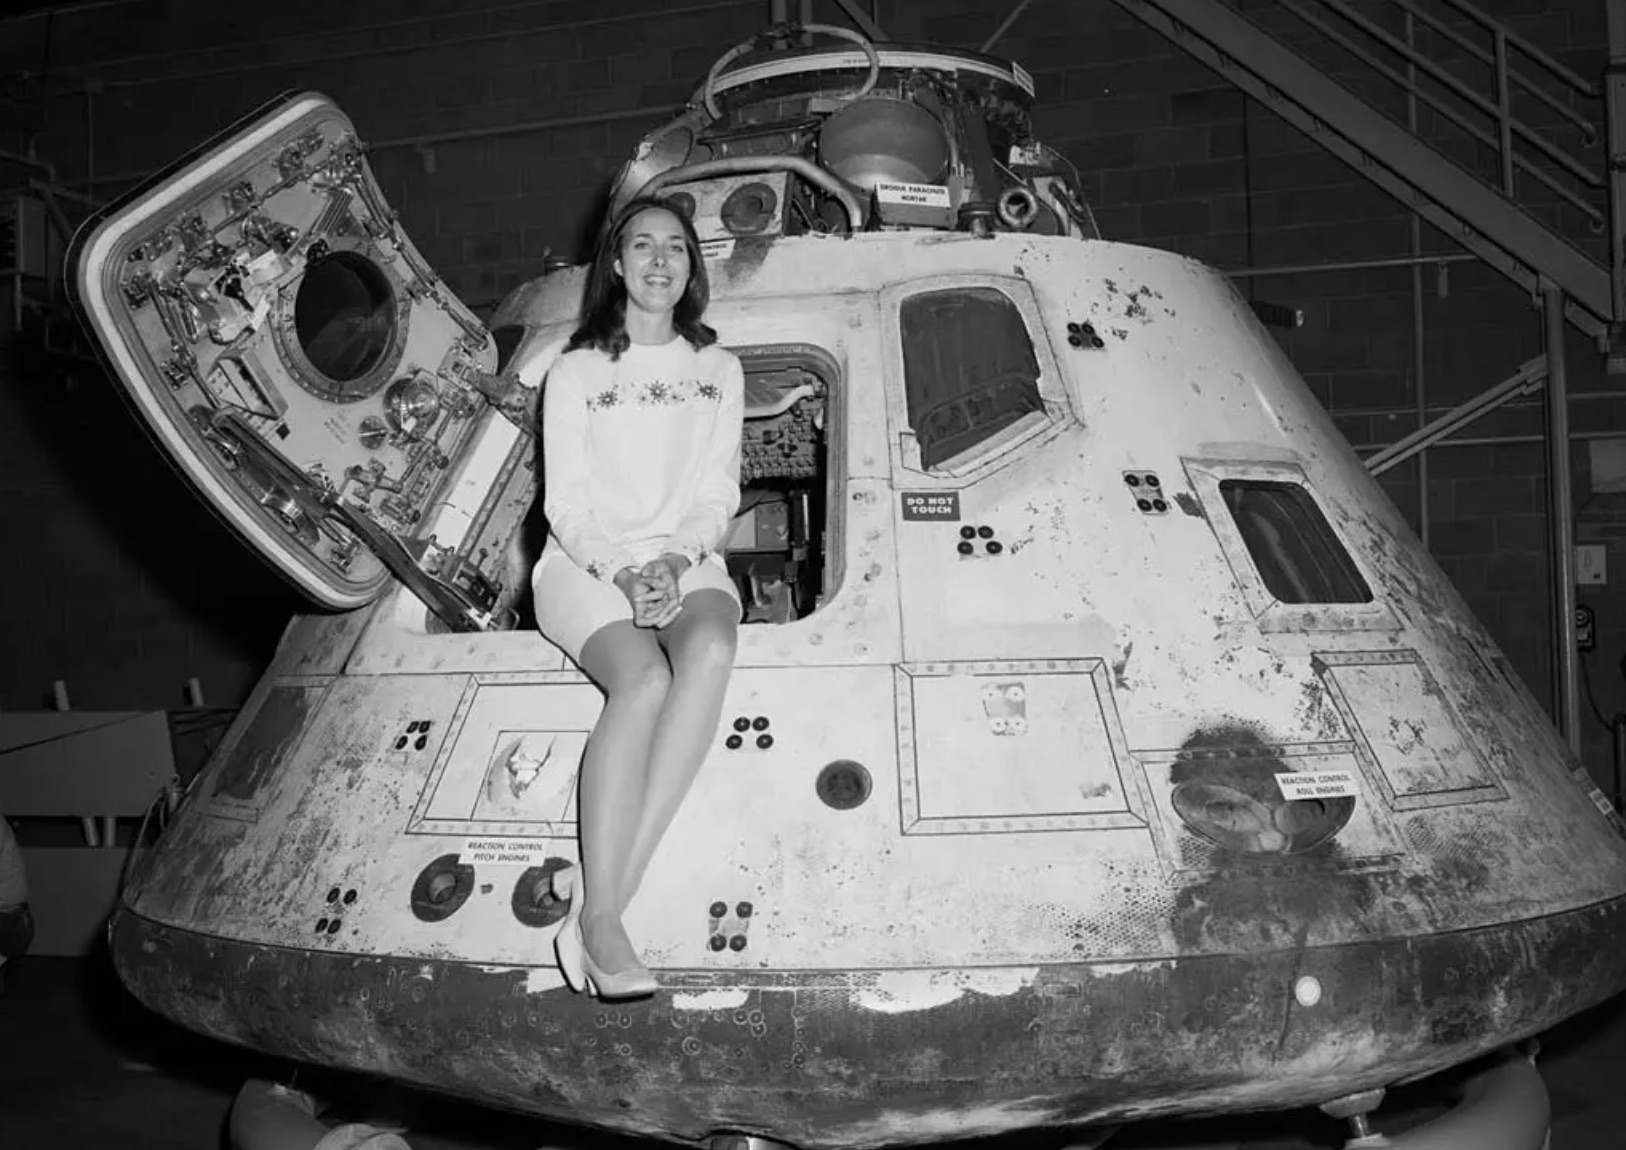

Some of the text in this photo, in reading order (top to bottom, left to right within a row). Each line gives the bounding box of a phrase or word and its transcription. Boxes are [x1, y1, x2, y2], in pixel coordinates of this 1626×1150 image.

[909, 186, 946, 195] PARACHUTE
[907, 497, 954, 506] DO NOT
[911, 506, 952, 514] TOUCH
[1280, 775, 1351, 784] REACTION CONTROL
[1296, 785, 1346, 795] ROLL ENGINES
[507, 843, 543, 851] CONTROL
[498, 854, 530, 862] ENGINES
